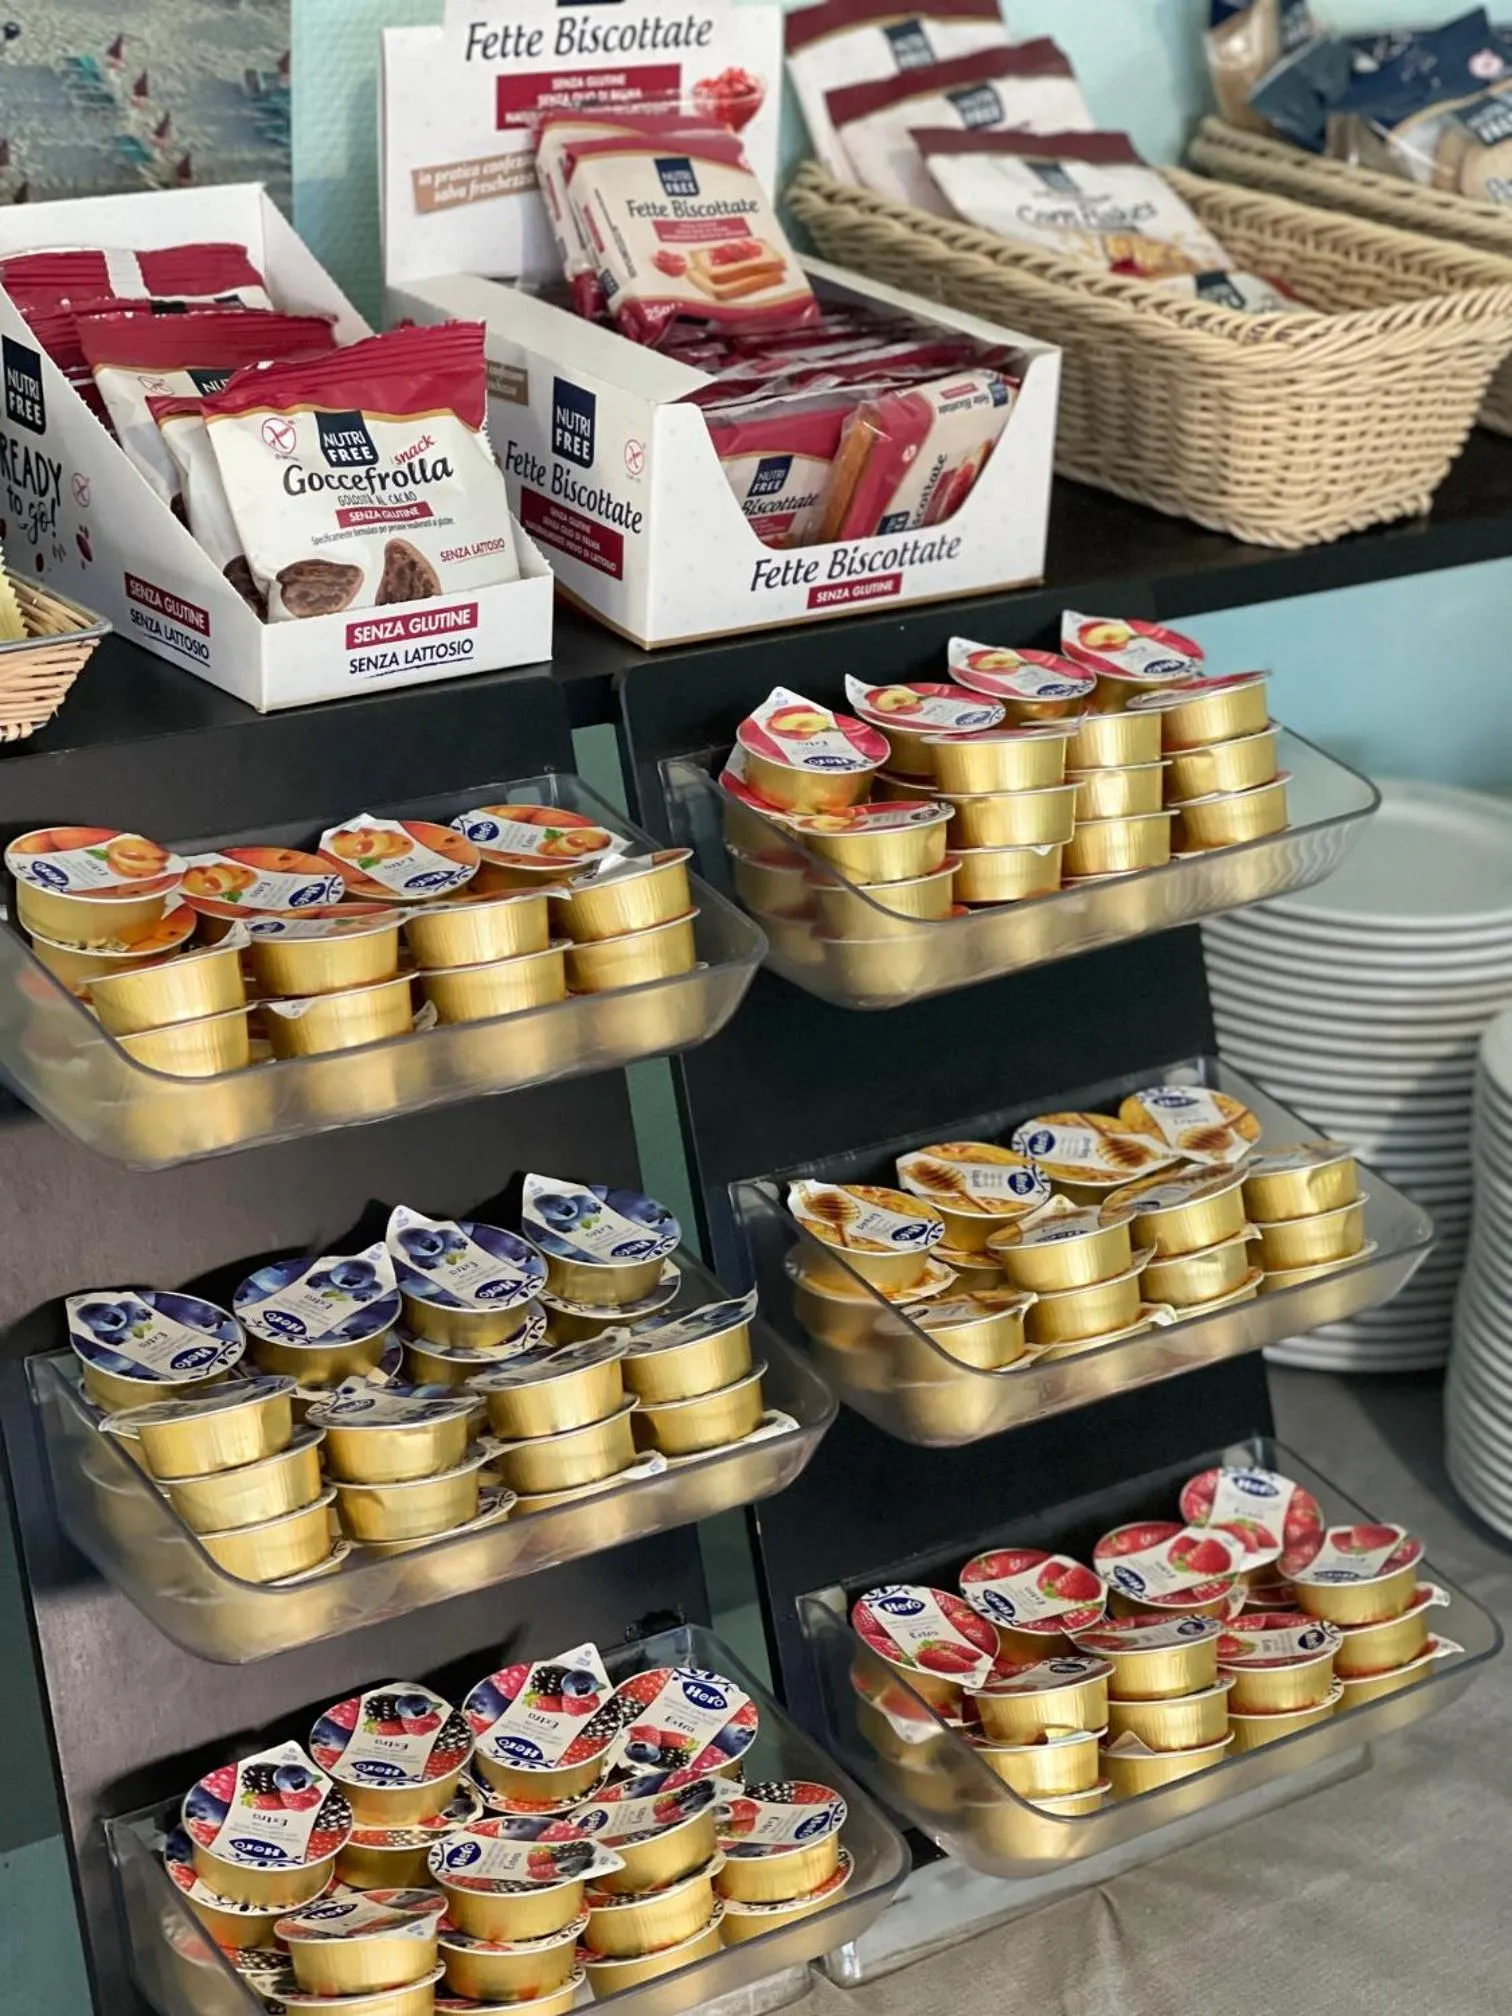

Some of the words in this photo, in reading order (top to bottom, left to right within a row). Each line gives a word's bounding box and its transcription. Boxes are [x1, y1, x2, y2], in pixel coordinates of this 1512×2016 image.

[465, 22, 544, 61] Fette
[554, 16, 713, 57] Biscottate
[552, 76, 584, 90] SENZA
[626, 200, 670, 218] Fette
[672, 199, 760, 218] Biscottate
[7, 367, 40, 401] NUTRI
[8, 391, 43, 426] FREE
[556, 404, 591, 438] NUTRI
[322, 430, 366, 448] NUTRI
[394, 433, 437, 466] snack
[555, 427, 591, 461] FREE
[329, 447, 373, 463] FREE
[0, 432, 62, 507] READY
[283, 456, 454, 497] Goccefrolla
[757, 469, 786, 482] NUTRI
[388, 490, 418, 505] CACAO
[504, 439, 547, 488] Fette
[551, 463, 643, 534] Biscottate
[751, 480, 783, 493] FREE
[7, 484, 23, 517] to
[27, 497, 57, 546] go!
[348, 510, 381, 522] SENZA
[381, 506, 421, 520] GLUTINE
[440, 546, 471, 563] SENZA
[471, 537, 506, 556] LATTOSIO
[750, 556, 820, 592] Fette
[827, 535, 962, 580] Biscottate
[816, 588, 851, 604] SENZA
[852, 579, 894, 598] GLUTINE
[128, 579, 163, 610] SENZA
[163, 597, 206, 631] GLUTINE
[129, 608, 162, 640] SENZA
[163, 626, 210, 660] LATTOSIO
[352, 620, 406, 645] SENZA
[407, 610, 472, 636] GLUTINE
[349, 654, 400, 675] SENZA
[403, 638, 474, 666] LATTOSIO
[808, 757, 852, 768] Hero
[470, 821, 493, 841] Hero
[33, 862, 68, 884] Hero
[409, 871, 450, 889] Hero
[293, 885, 322, 906] Hero
[617, 1240, 652, 1257] Hero
[477, 1280, 519, 1299] Hero
[265, 1311, 305, 1335] Hero
[174, 1347, 213, 1370] Hero
[1114, 1566, 1146, 1592] Hero
[884, 1599, 923, 1614] Hero
[984, 1591, 1016, 1615] Hero
[686, 1685, 724, 1709] Hero
[526, 1712, 559, 1729] Extra
[664, 1716, 694, 1732] Extra
[374, 1739, 408, 1750] Extra
[498, 1737, 540, 1759] Hero
[354, 1762, 400, 1776] Hero
[251, 1812, 289, 1826] Extra
[585, 1810, 605, 1832] Hero
[800, 1815, 825, 1839] Hero
[233, 1840, 281, 1857] Hero
[453, 1843, 477, 1868] Hero
